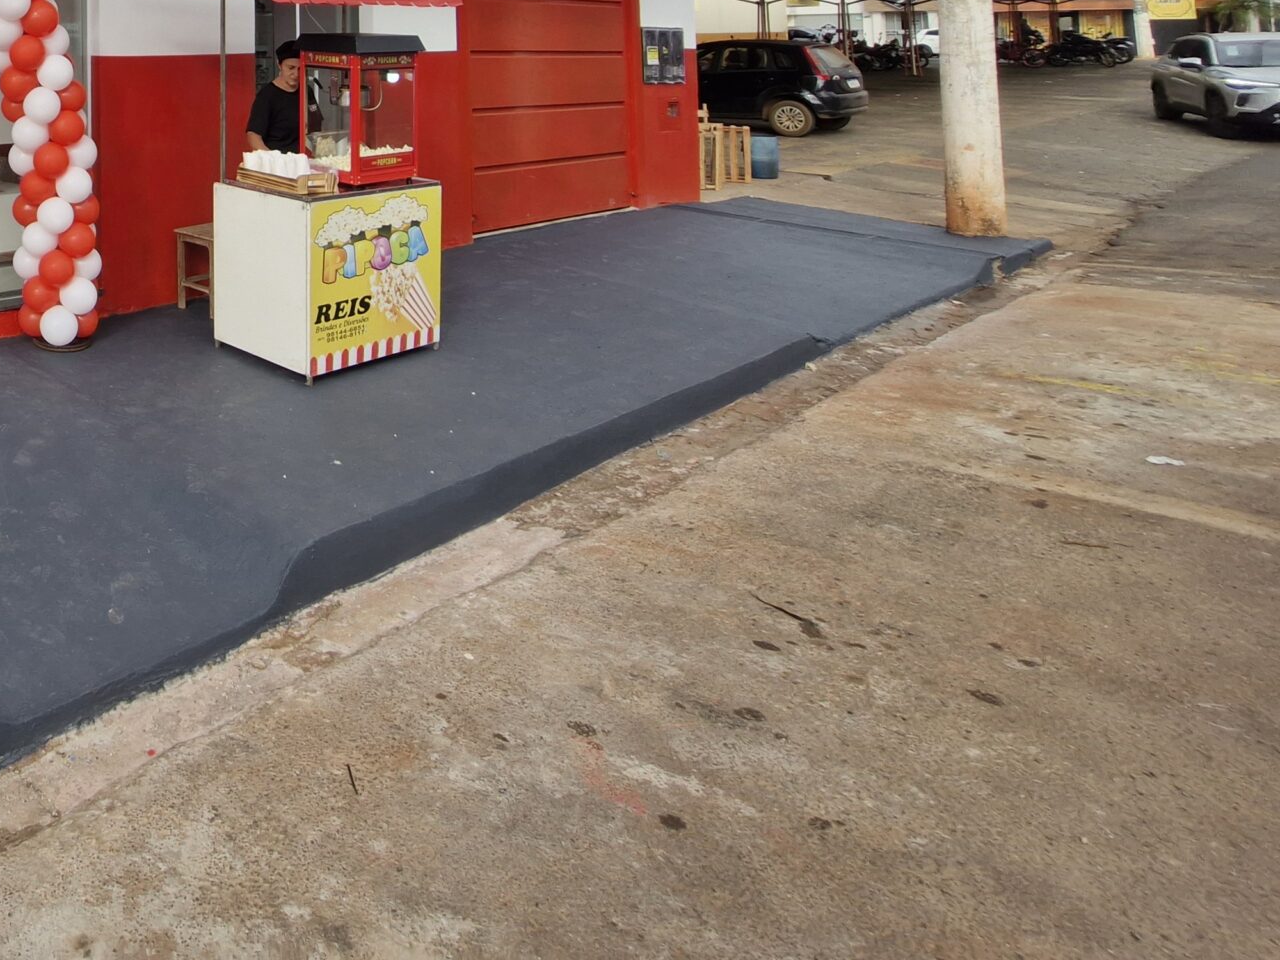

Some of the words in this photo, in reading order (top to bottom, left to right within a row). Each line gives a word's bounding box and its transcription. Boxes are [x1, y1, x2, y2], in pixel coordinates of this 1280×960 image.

[315, 54, 339, 63] POPCORN
[377, 56, 398, 64] POPCORN
[377, 157, 397, 166] POPCORN
[322, 226, 429, 284] PIPOCA
[314, 295, 372, 325] REIS
